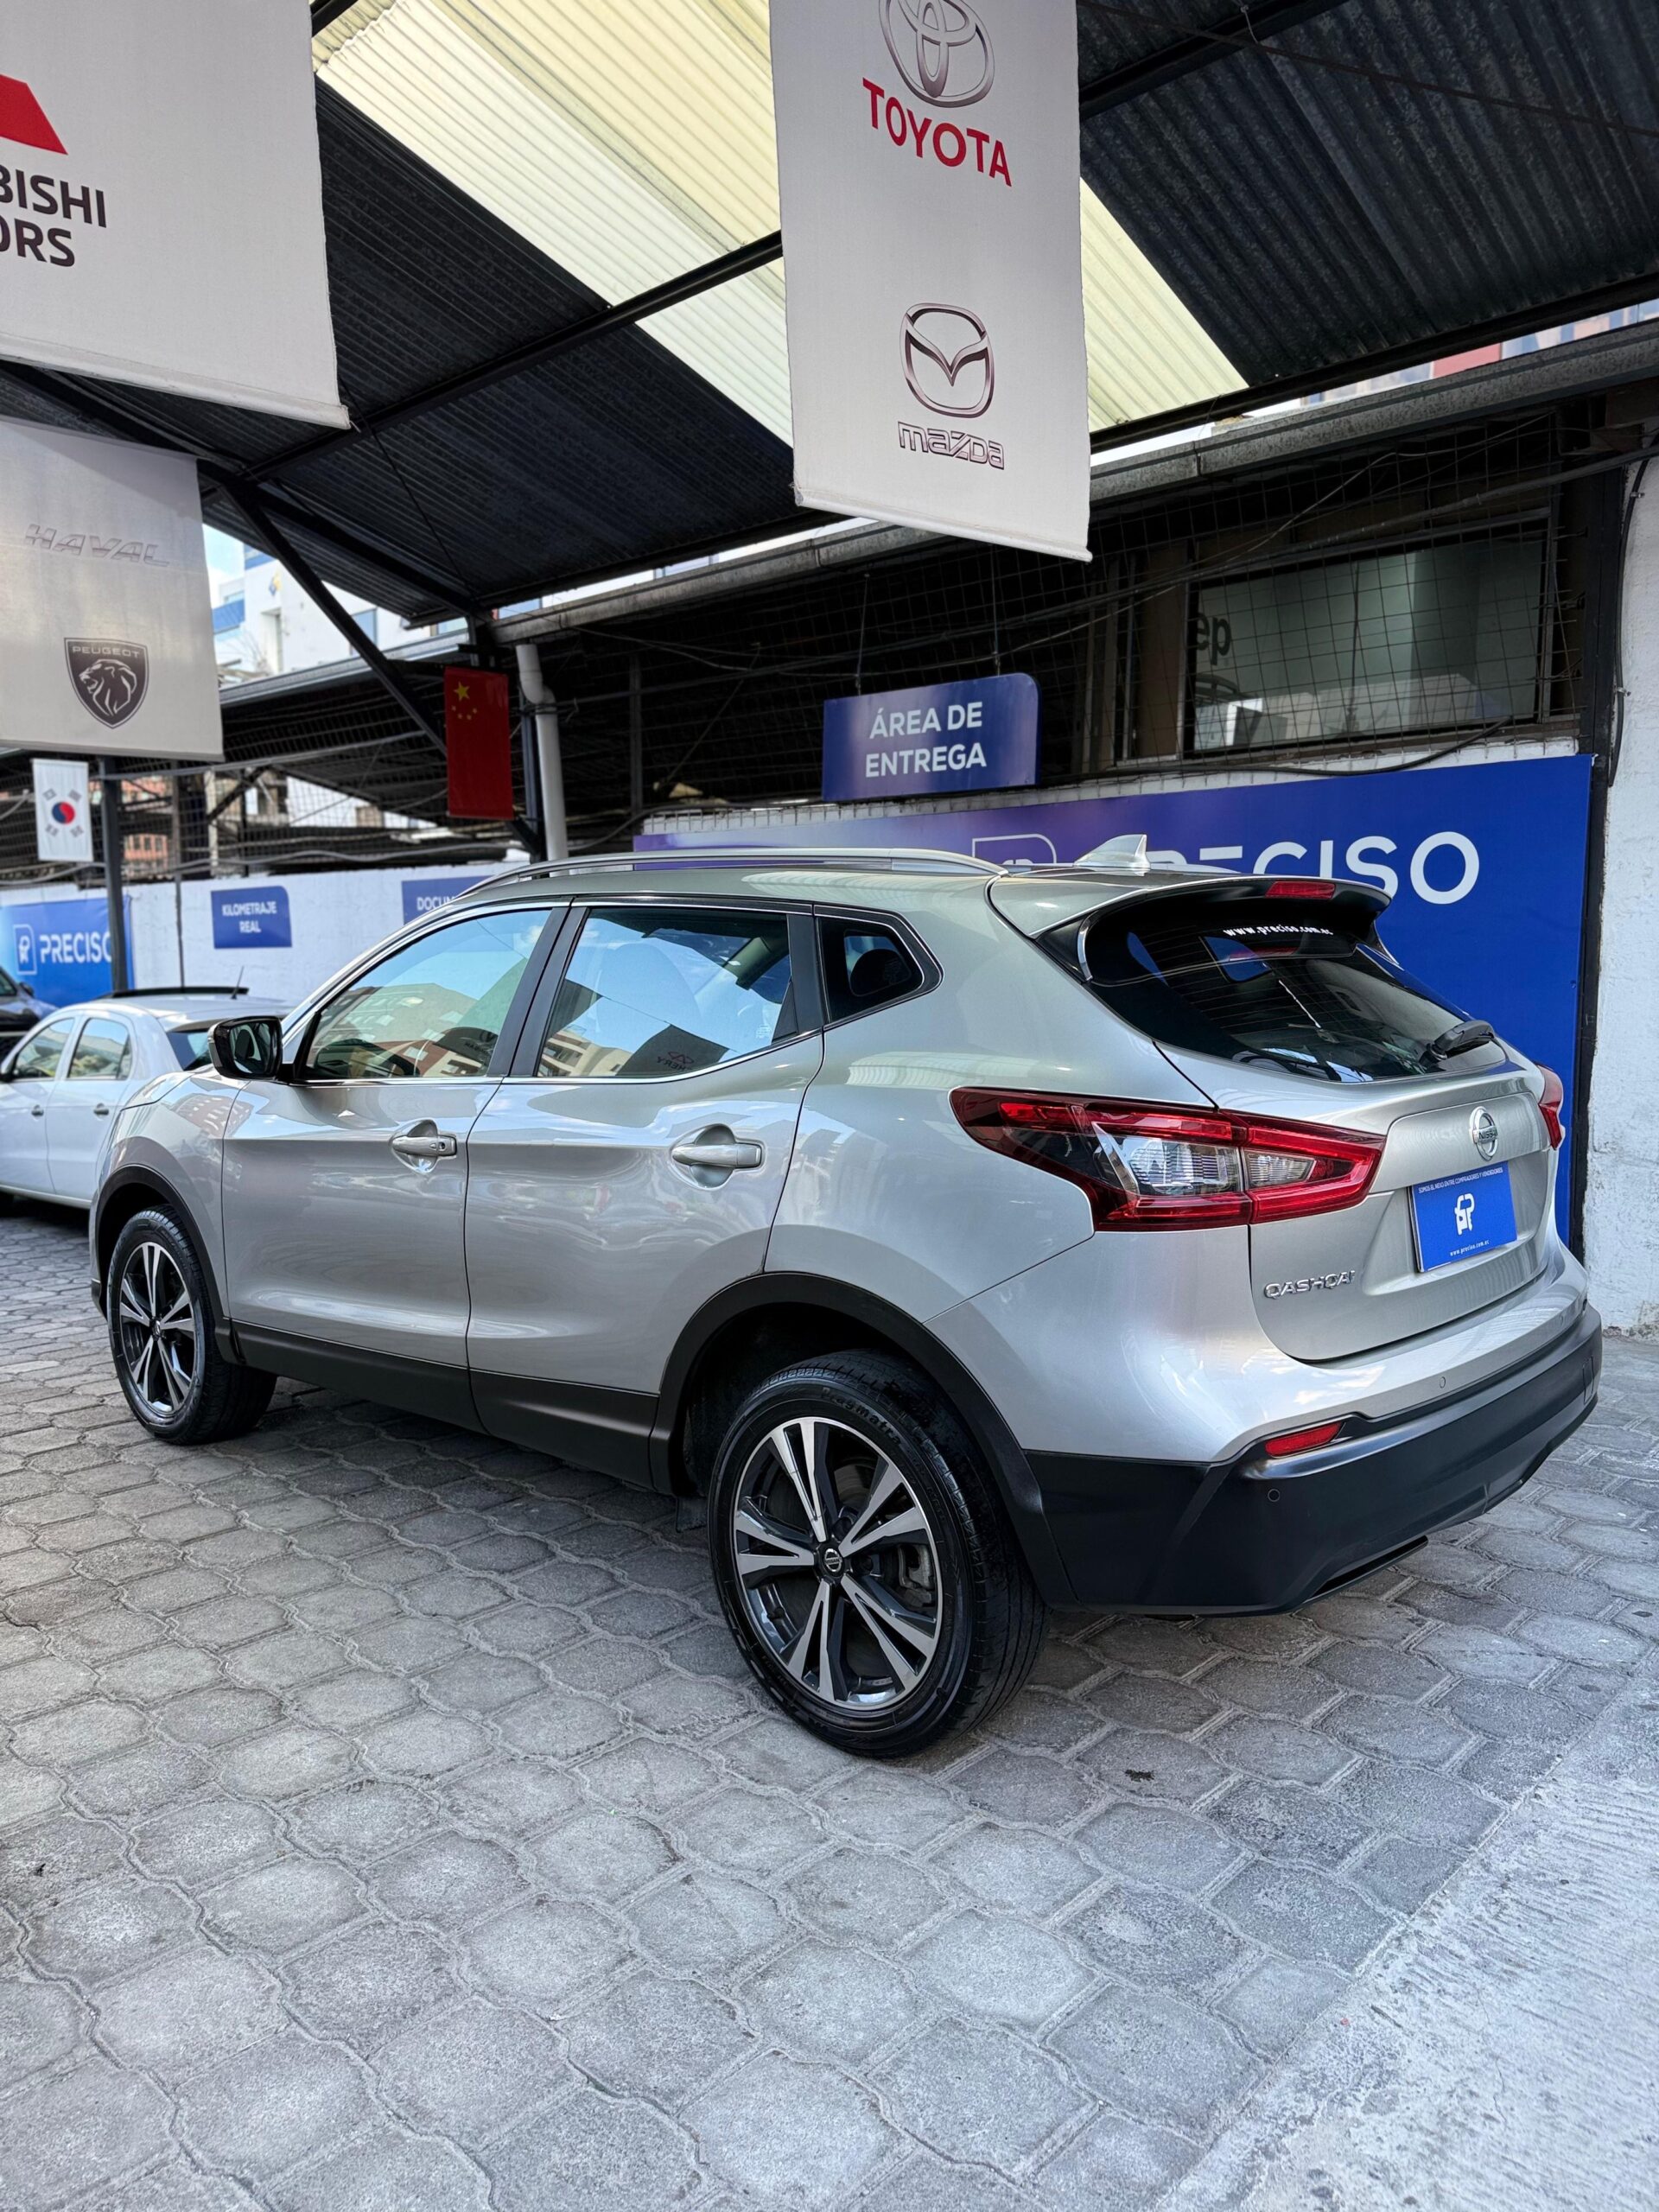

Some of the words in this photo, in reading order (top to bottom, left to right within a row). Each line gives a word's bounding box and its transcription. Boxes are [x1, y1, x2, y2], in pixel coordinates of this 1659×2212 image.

[862, 77, 1012, 188] TOYOTA
[25, 524, 170, 567] HAVAL
[72, 645, 139, 658] PEUGEOT
[869, 708, 941, 739] ÁREA
[948, 702, 982, 730] DE
[866, 742, 987, 778] ENTREGA
[222, 901, 276, 916] KILOMETRAJE
[239, 920, 262, 933] REAL
[1223, 924, 1333, 936] www.preciso.com.ec
[1264, 1270, 1355, 1299] QASHQAI
